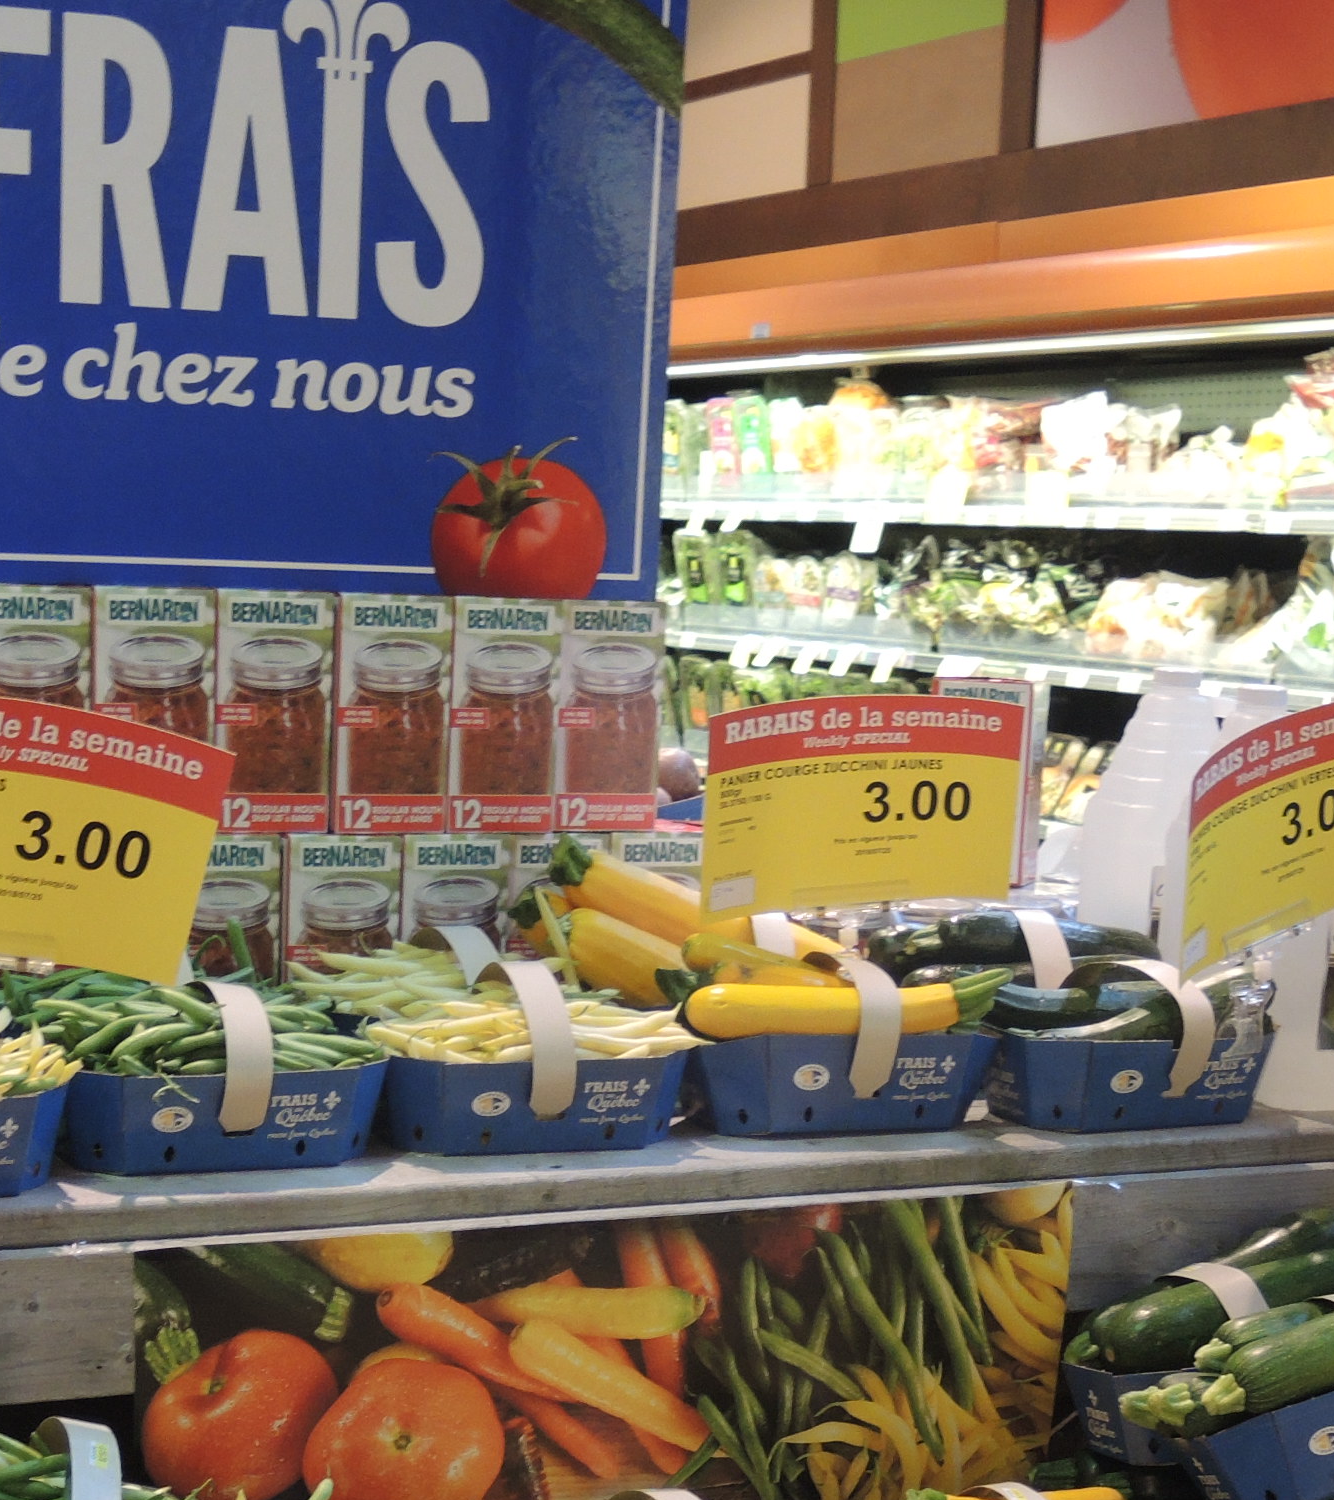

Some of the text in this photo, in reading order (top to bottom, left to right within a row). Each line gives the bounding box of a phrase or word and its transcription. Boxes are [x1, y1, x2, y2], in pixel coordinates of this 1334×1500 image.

[63, 321, 260, 410] chez
[272, 356, 475, 419] nous
[353, 603, 439, 628] BERNARDIN
[725, 706, 1002, 744] RABAIS de la semaine
[29, 715, 59, 746] la
[68, 727, 205, 781] semaine
[803, 732, 911, 749] Weekly SPECIAL
[1246, 738, 1269, 769] de
[1274, 729, 1294, 757] la
[16, 747, 89, 772] SPECIAL
[720, 758, 943, 788] PANIER COURGE ZUCCHINI JAUNES
[223, 797, 251, 829] 12
[341, 799, 372, 830] 12
[452, 799, 482, 829] 12
[559, 797, 587, 827] 12
[863, 780, 971, 823] 3.00
[15, 810, 151, 879] 3.00
[303, 844, 386, 869] BERNARDIN
[583, 1079, 629, 1094] FRAIS
[587, 1093, 641, 1111] Québec
[275, 1108, 332, 1128] Québec
